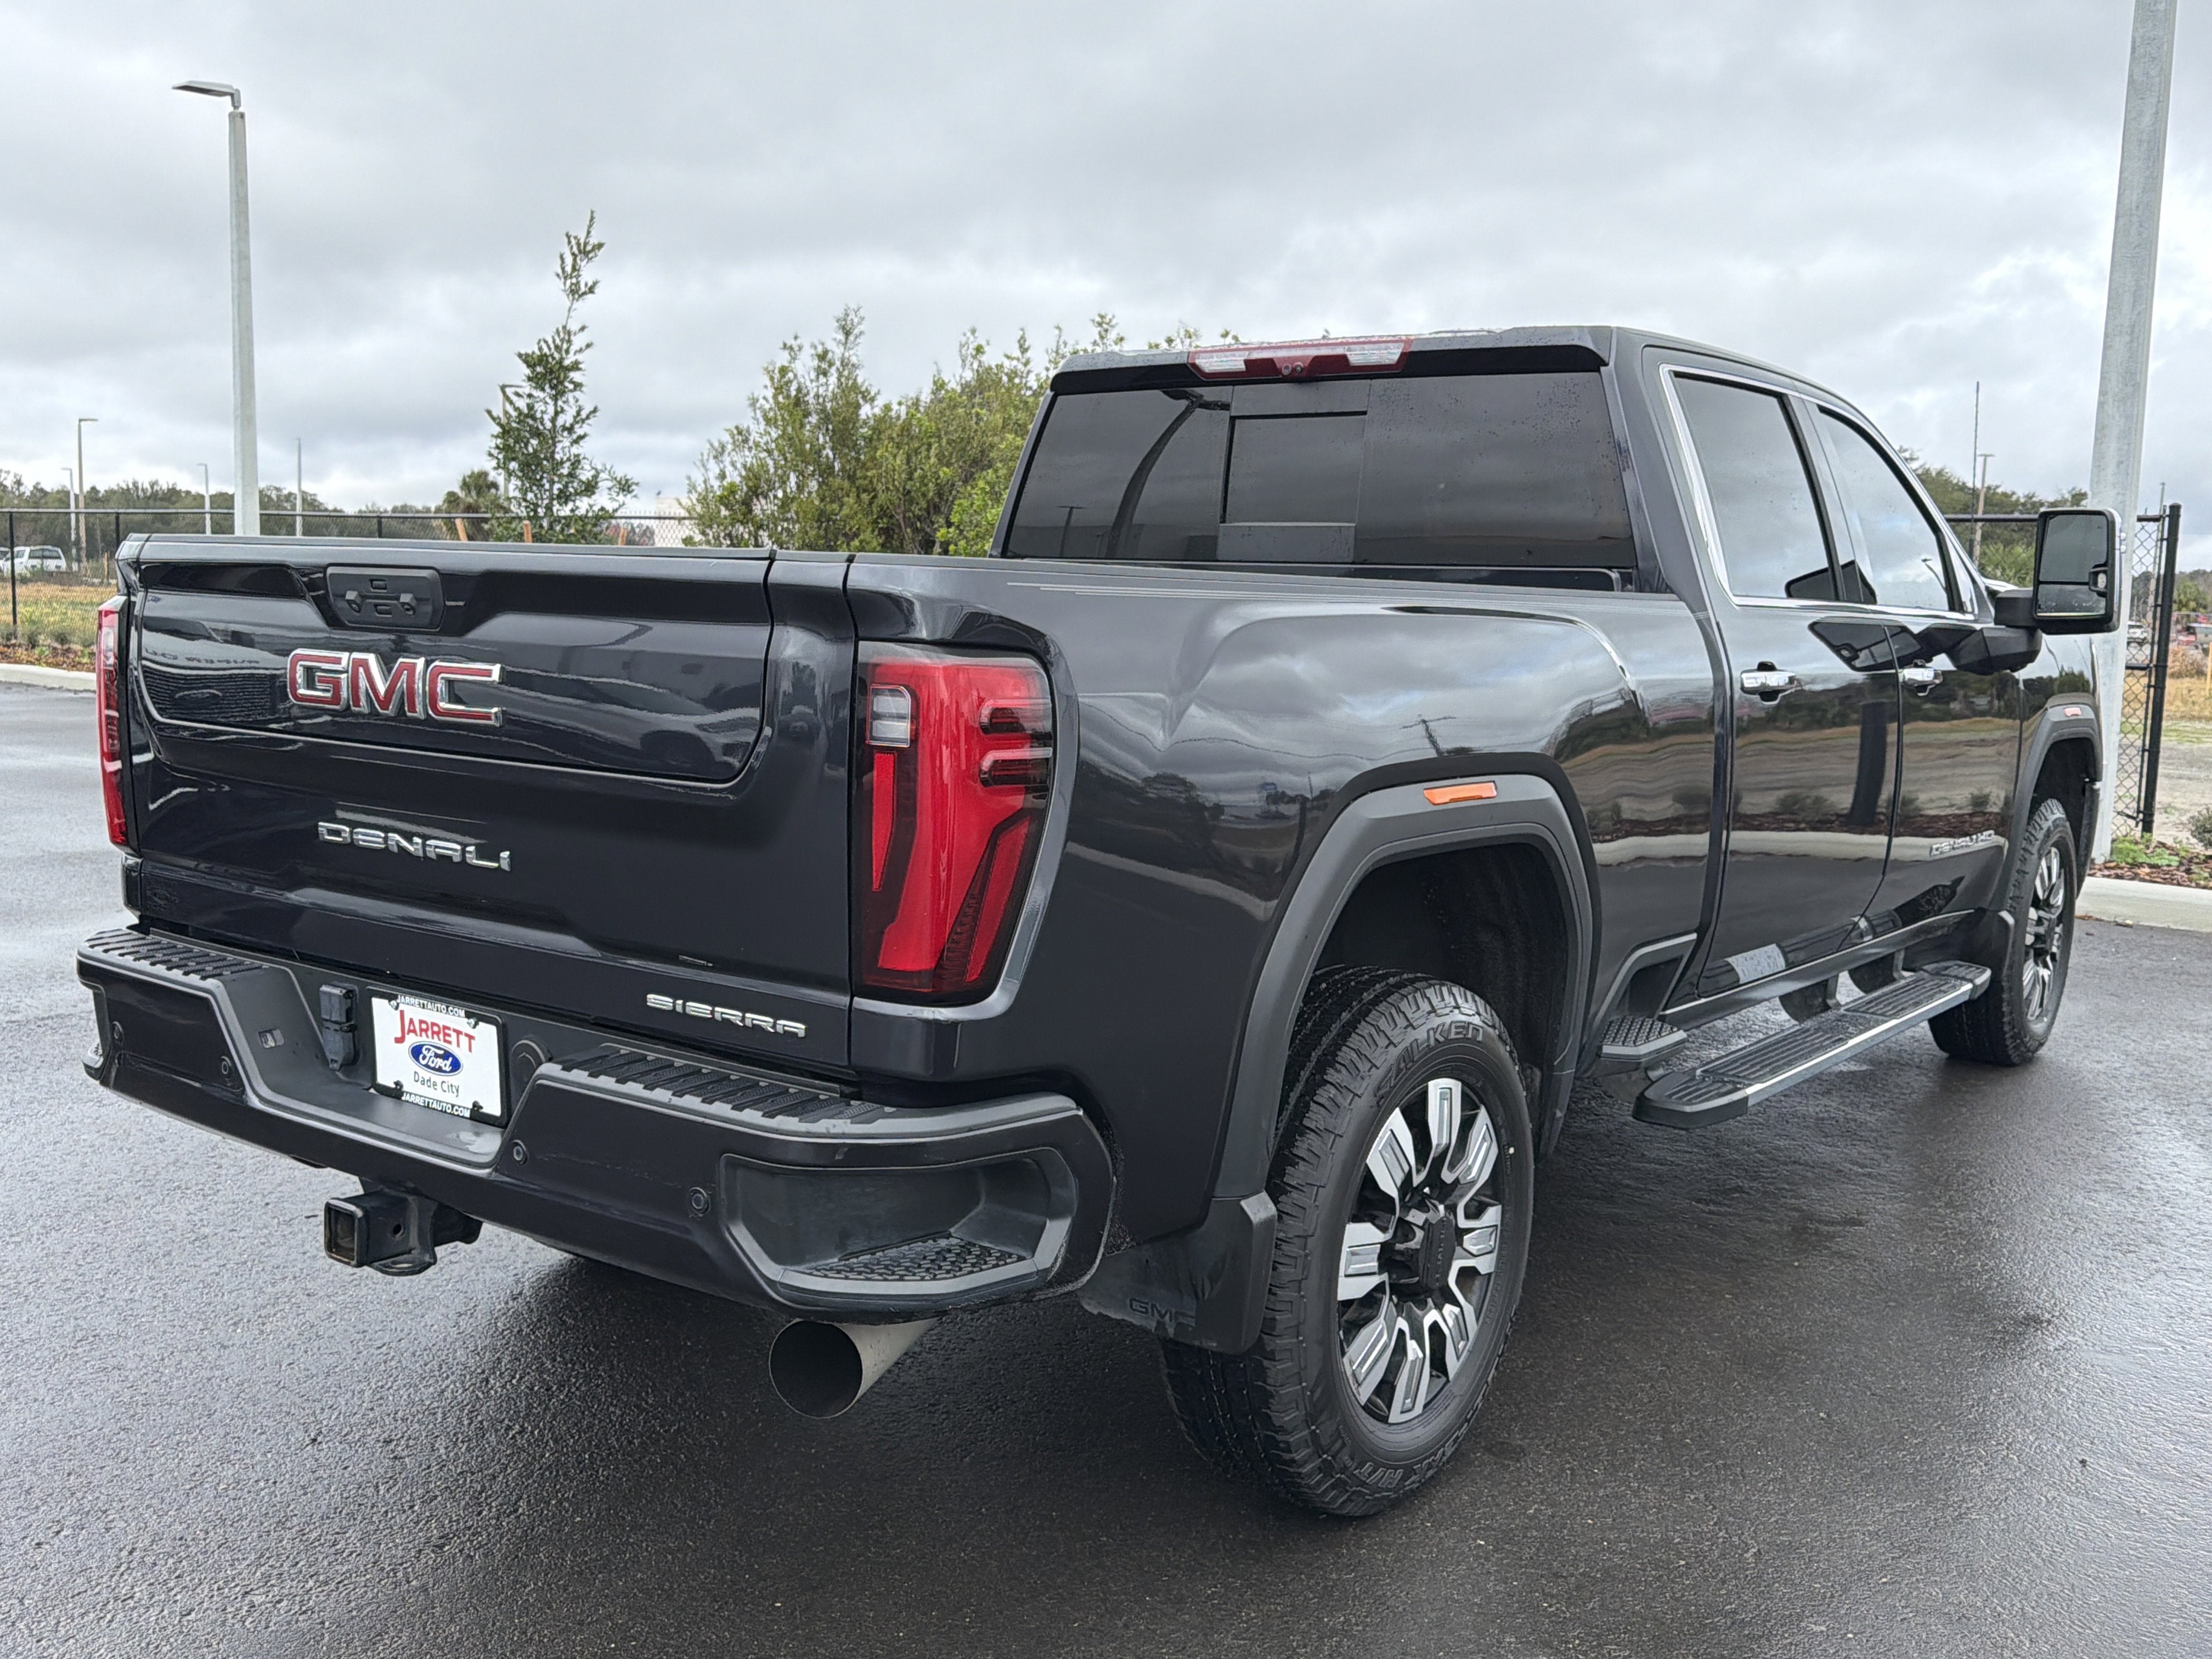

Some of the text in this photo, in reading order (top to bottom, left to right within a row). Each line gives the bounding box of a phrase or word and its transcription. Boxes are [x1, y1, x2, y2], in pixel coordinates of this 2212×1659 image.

[287, 648, 504, 728] GMC
[318, 821, 512, 872] DENALI
[396, 995, 466, 1018] JARRETTAUTO.COM
[646, 994, 807, 1038] SIERRA
[394, 1009, 476, 1053] JARRETT
[419, 1045, 453, 1072] Ford
[413, 1070, 460, 1098] Dade City
[402, 1092, 471, 1119] JARRETTAUTO.COM
